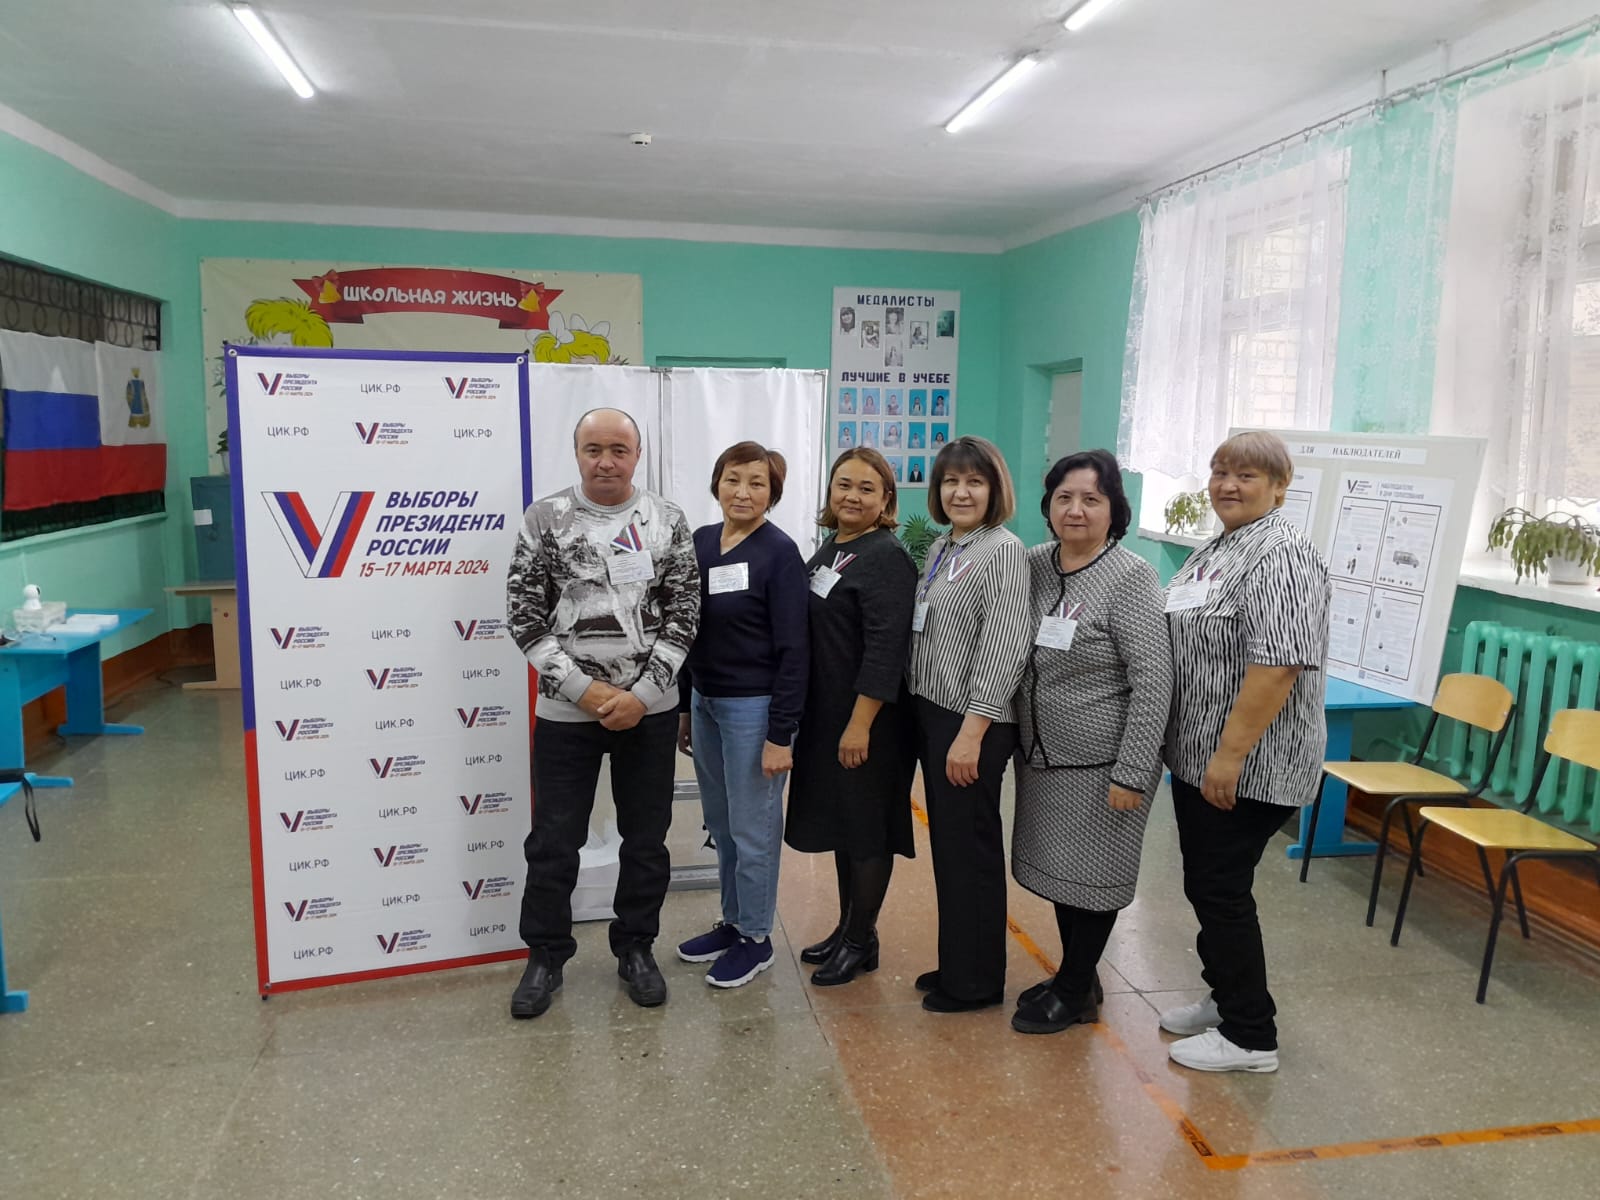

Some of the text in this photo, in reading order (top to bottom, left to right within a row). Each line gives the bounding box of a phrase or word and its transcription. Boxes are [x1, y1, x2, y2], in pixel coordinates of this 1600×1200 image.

[343, 286, 518, 308] ШКОЛЬНАЯ ЖИЗНЬ
[857, 294, 935, 307] МЕДАЛИСТЫ
[841, 371, 951, 384] ЛУЧШИЕ В УЧЕБЕ
[361, 384, 400, 394] ЦИК.РФ
[267, 427, 309, 437] ЦИК.РФ
[453, 429, 492, 439] ЦИК.РФ
[1332, 446, 1402, 460] НАБЛЮДАТЕЛЕЙ
[385, 491, 478, 508] ВЫБОРЫ
[376, 513, 505, 534] ПРЕЗИДЕНТА
[366, 538, 451, 557] РОССИИ
[402, 561, 451, 576] МАРТА
[454, 559, 489, 575] 2024
[371, 629, 411, 640] ЦИК.РФ
[462, 669, 500, 680] ЦИК.РФ
[280, 679, 322, 690] ЦИК.РФ
[375, 719, 415, 730] ЦИК.РФ
[465, 754, 503, 766] ЦИК.РФ
[285, 769, 326, 781] ЦИК.РФ
[378, 807, 418, 818] ЦИК.РФ
[467, 840, 505, 852] ЦИК.РФ
[289, 859, 330, 872] ЦИК.РФ
[382, 894, 421, 907] ЦИК.РФ
[469, 924, 507, 937] ЦИК.РФ
[293, 947, 334, 960] ЦИК.РФ
